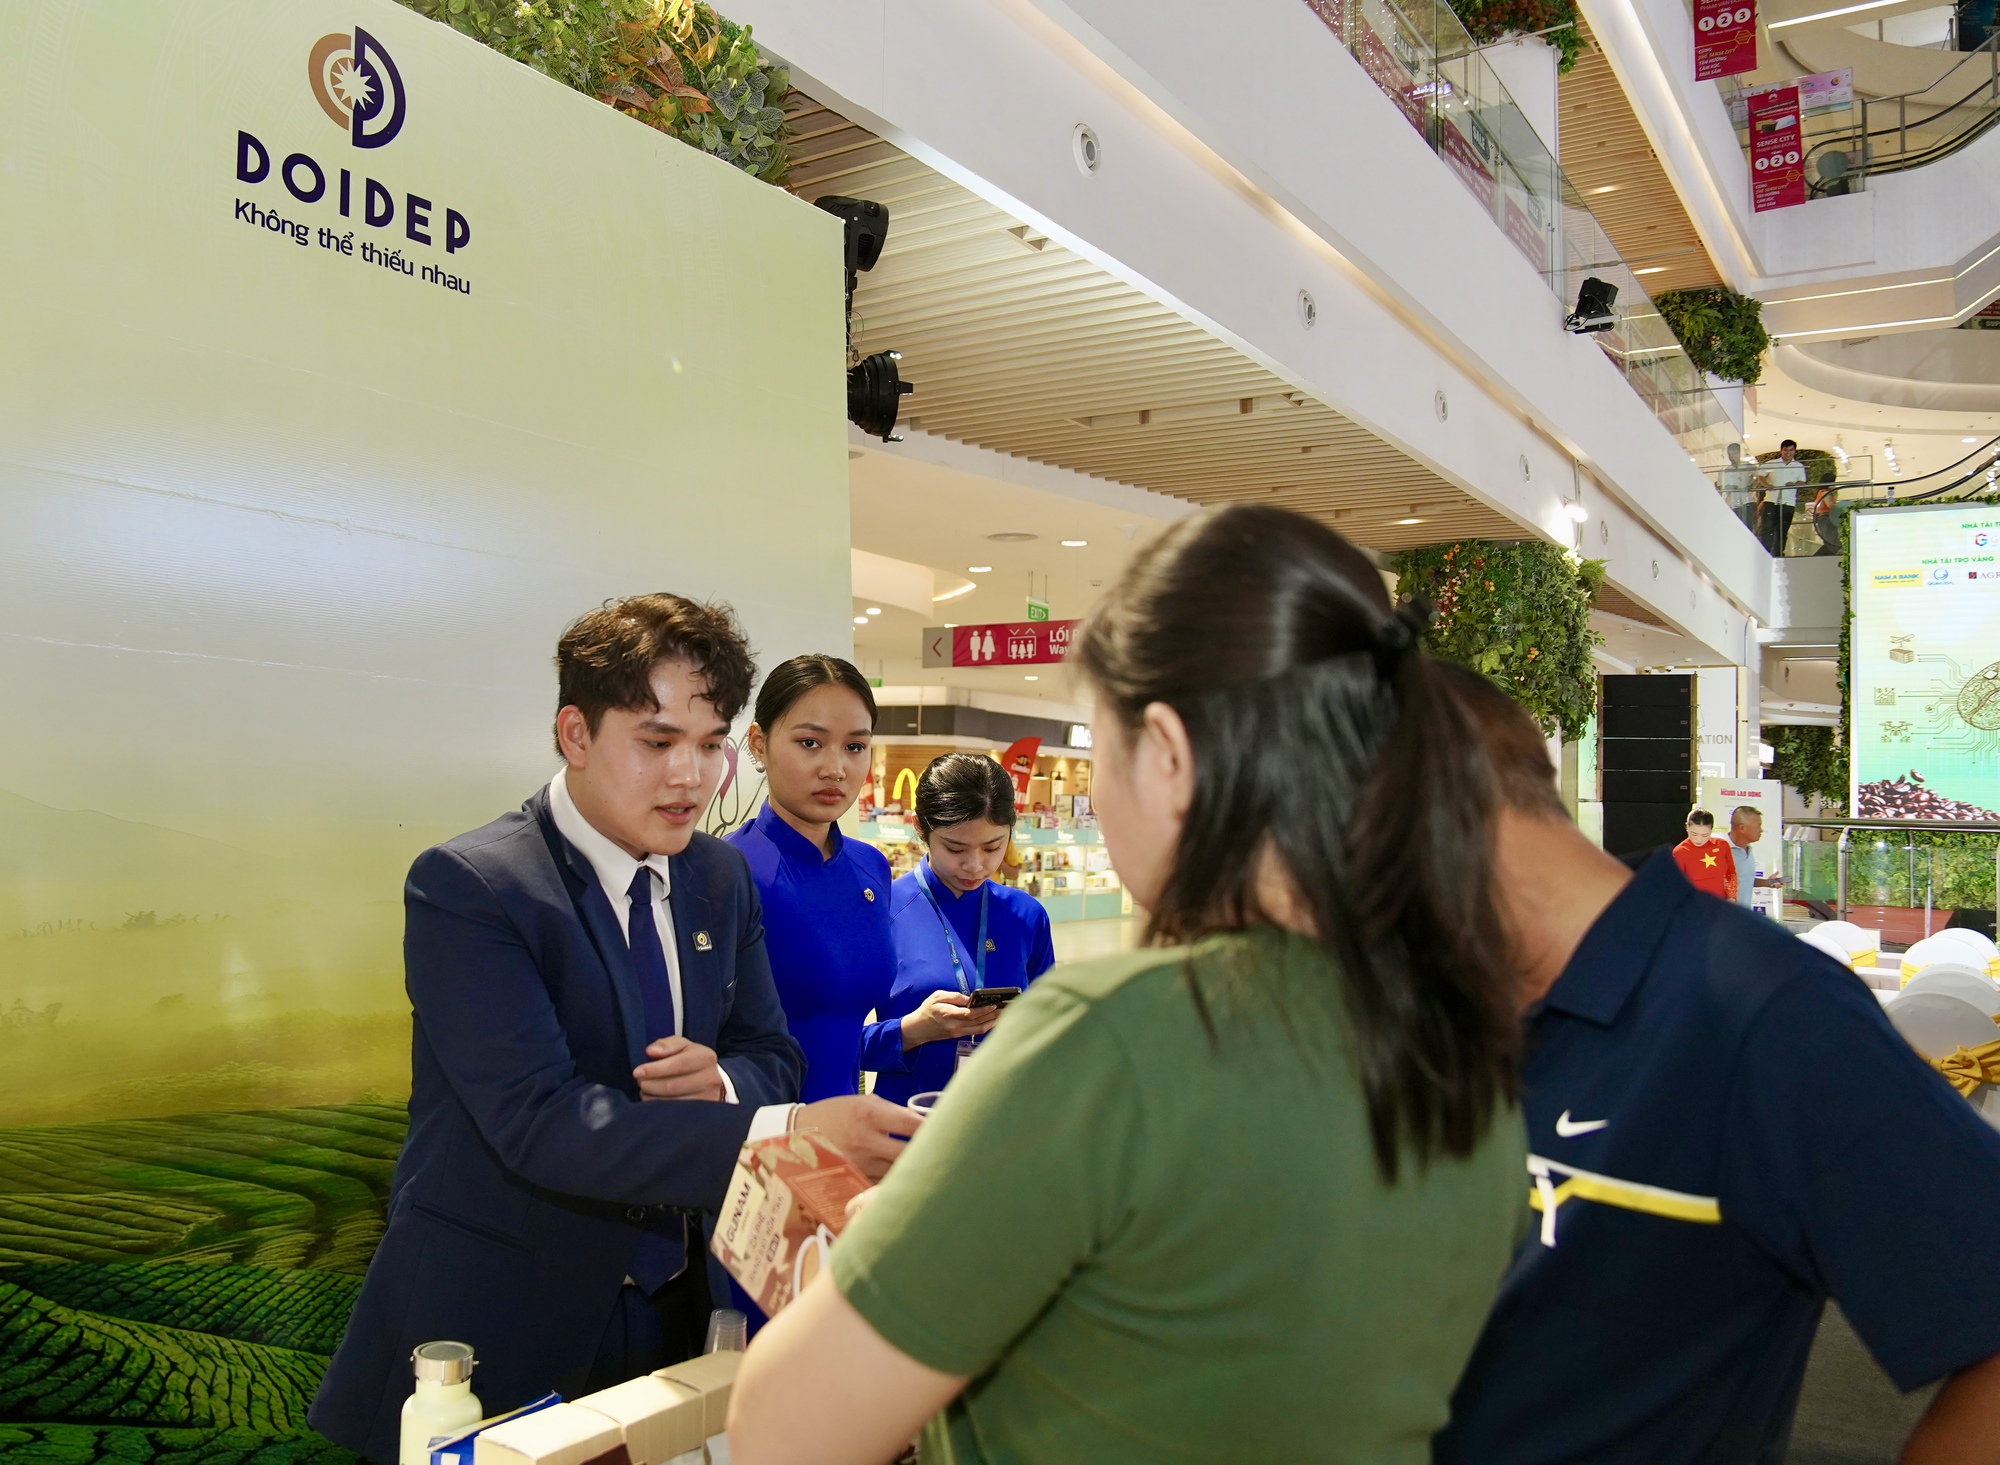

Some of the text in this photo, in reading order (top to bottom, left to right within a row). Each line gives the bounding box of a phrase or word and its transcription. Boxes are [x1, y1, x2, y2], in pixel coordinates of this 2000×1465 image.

[1473, 125, 1486, 151] SALE
[1756, 138, 1779, 148] SENSE
[1780, 134, 1795, 142] CITY
[236, 129, 471, 254] DOIDEP
[235, 198, 471, 295] Không thể thiếu nhau
[1031, 606, 1042, 620] EXIT
[1050, 625, 1069, 643] LỐI
[1049, 644, 1070, 656] Way
